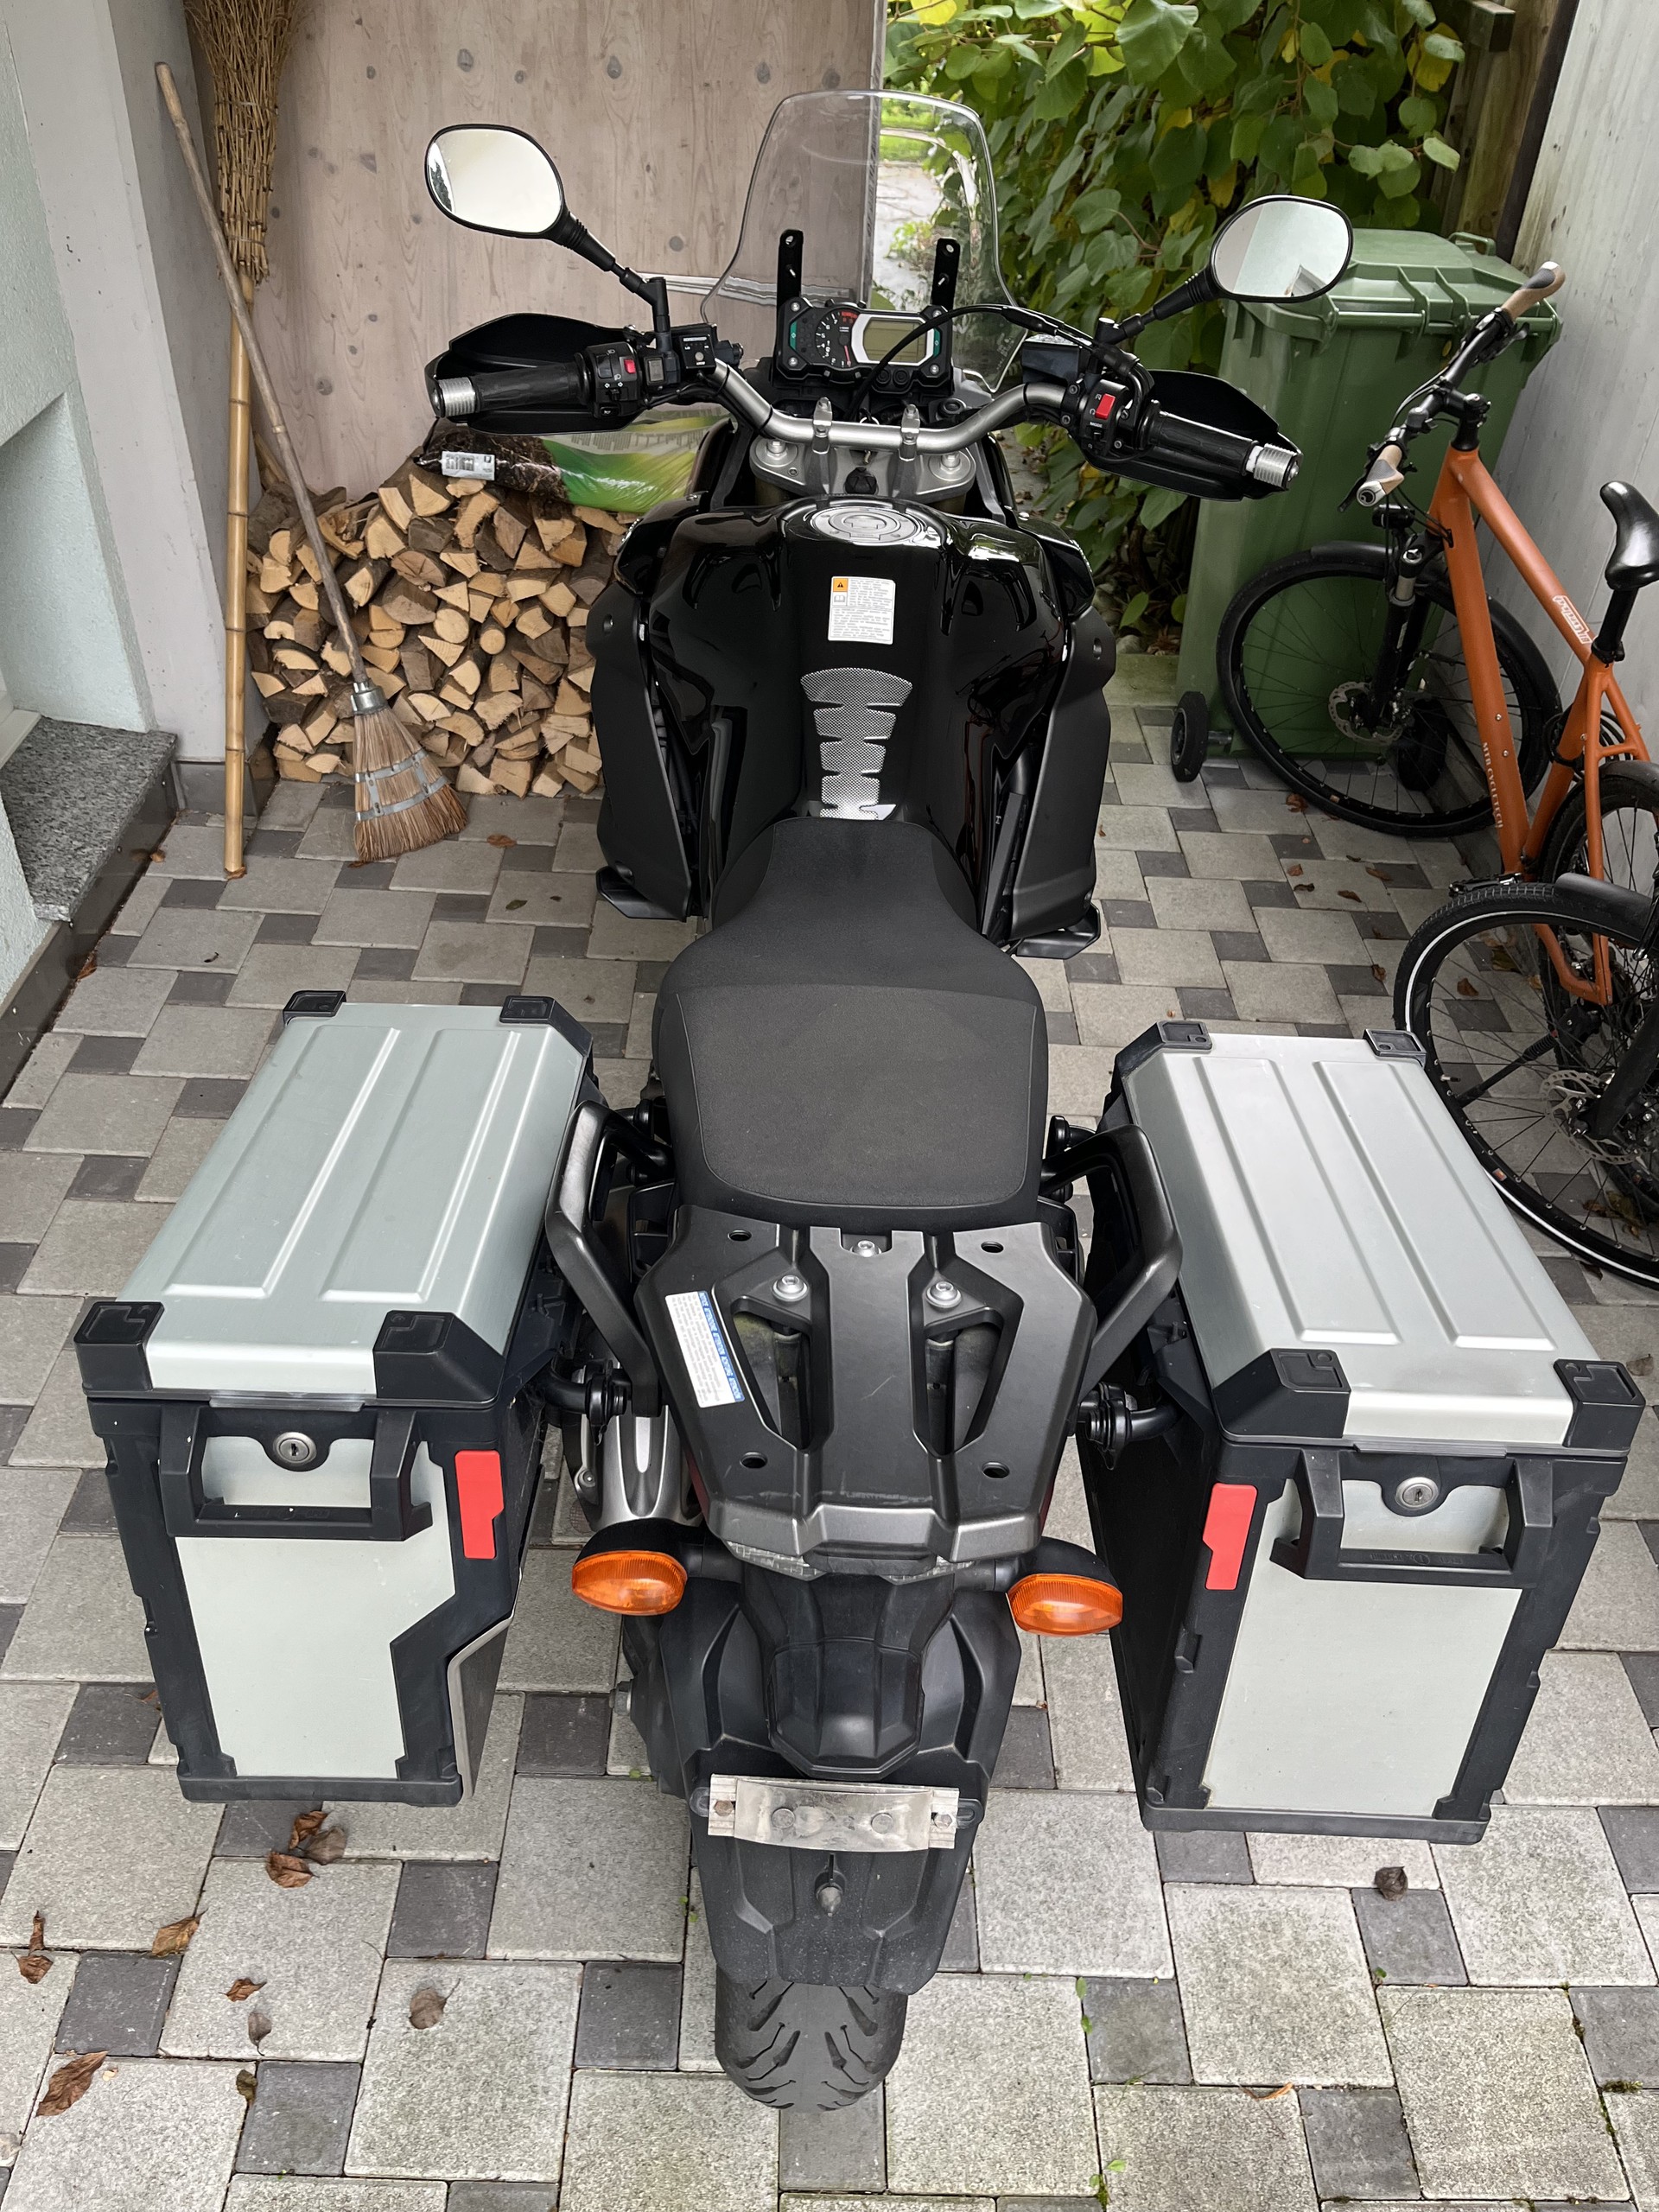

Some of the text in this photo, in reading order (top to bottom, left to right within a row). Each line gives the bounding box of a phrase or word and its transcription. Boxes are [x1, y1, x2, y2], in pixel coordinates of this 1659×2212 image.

[1482, 741, 1491, 766] MTB
[699, 1292, 709, 1307] NOTICE
[721, 1356, 734, 1376] ACHTUNG
